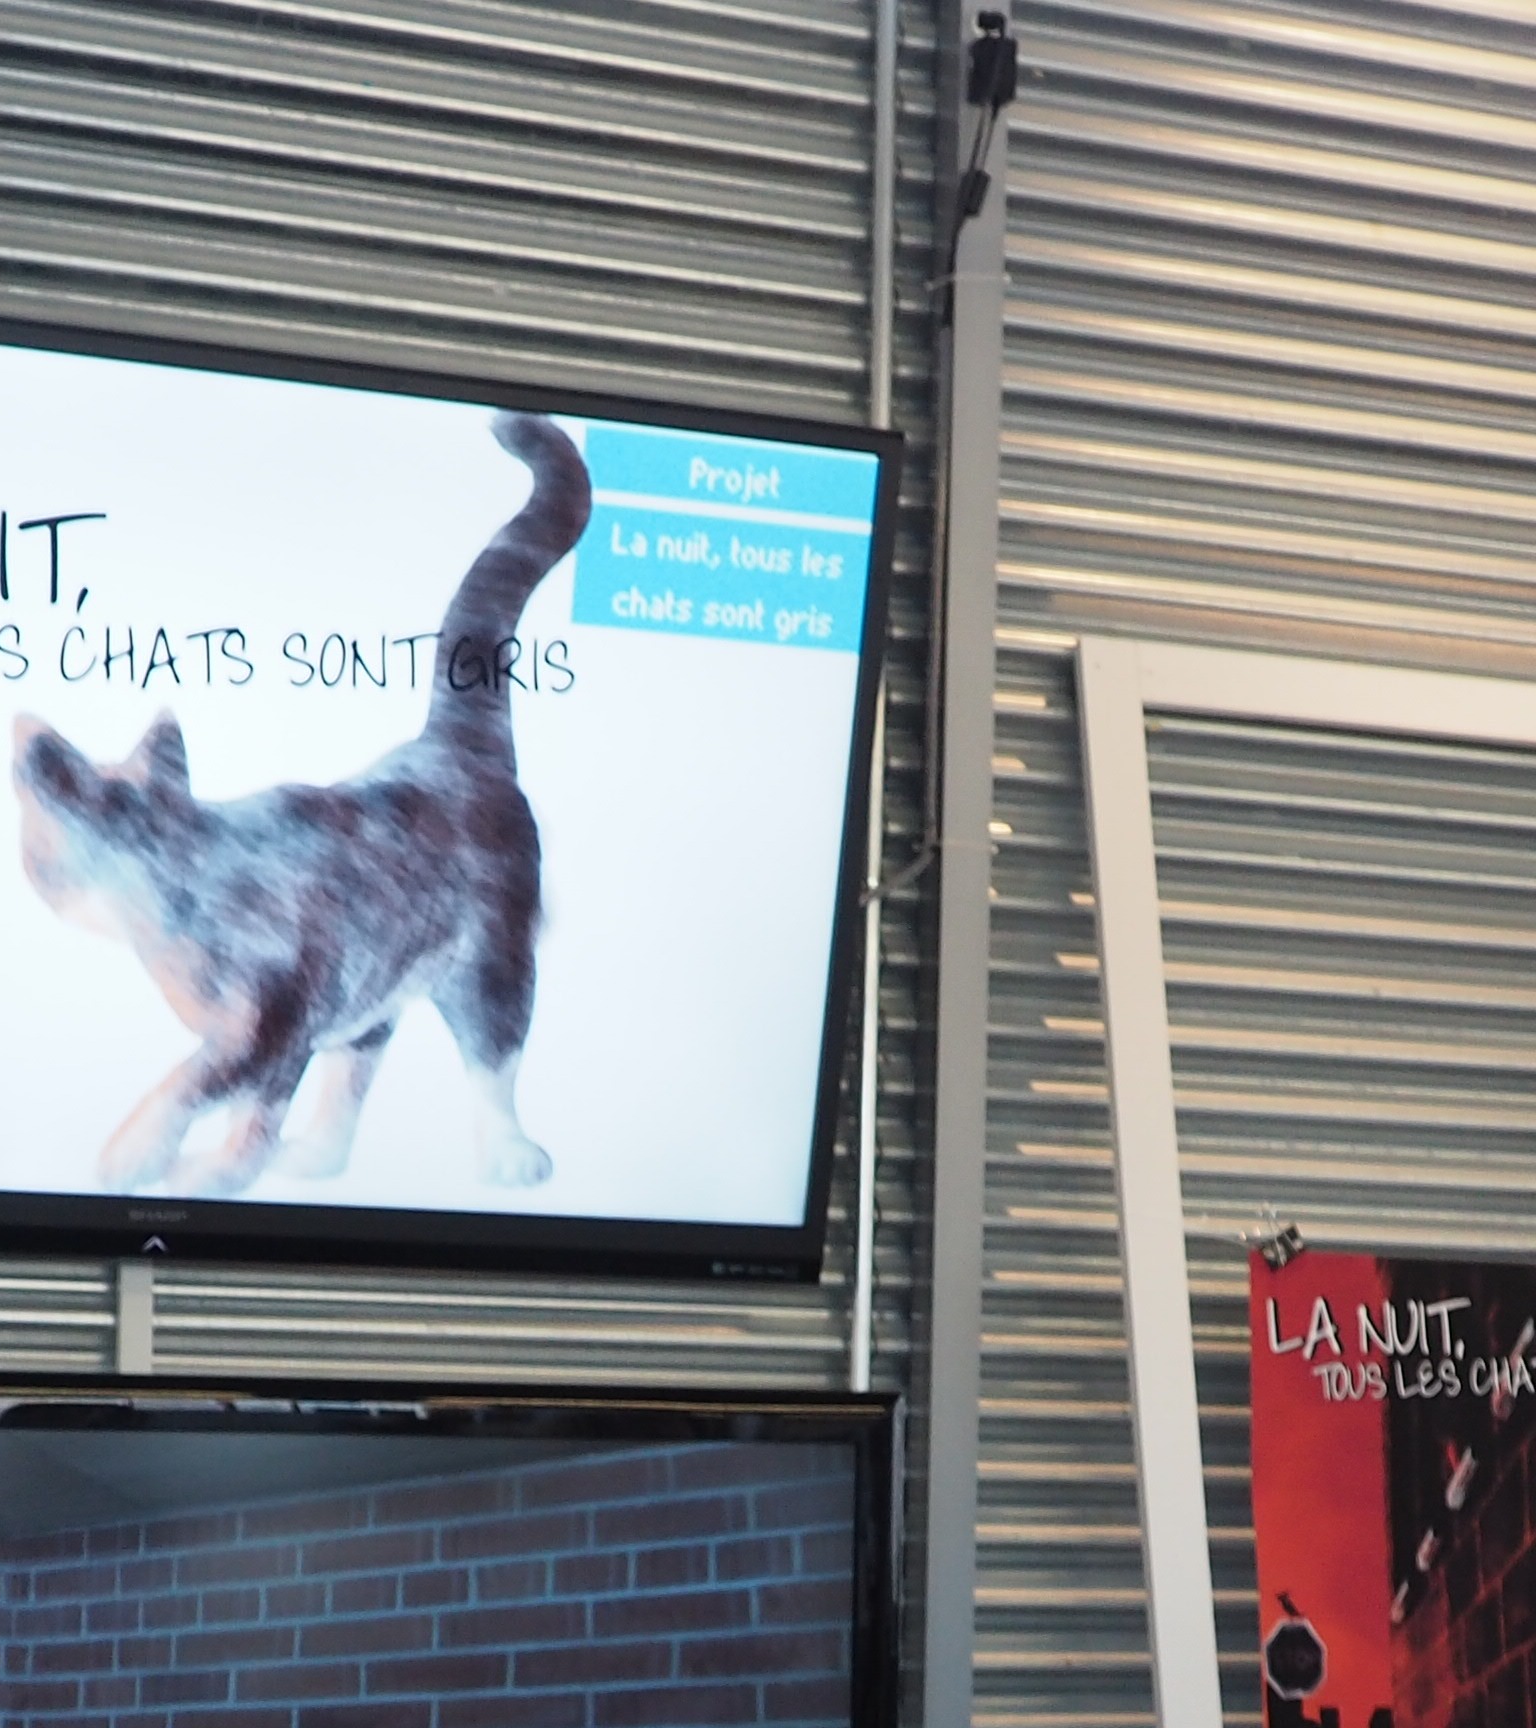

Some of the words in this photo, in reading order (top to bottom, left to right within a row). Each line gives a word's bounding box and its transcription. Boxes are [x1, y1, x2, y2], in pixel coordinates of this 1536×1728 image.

[689, 456, 781, 504] Projet
[611, 522, 647, 558] La
[657, 531, 721, 570] nuit,
[731, 535, 793, 574] tous
[801, 545, 844, 579] les
[612, 585, 693, 624] chats
[702, 599, 764, 631] sont
[774, 605, 833, 641] gris
[58, 620, 254, 690] CHATS
[283, 629, 443, 692] SONT
[445, 636, 577, 694] GRIS
[1266, 1297, 1343, 1360] LA
[1357, 1297, 1471, 1360] NUIT,
[1313, 1361, 1388, 1402] TOUS
[1394, 1357, 1462, 1398] LES
